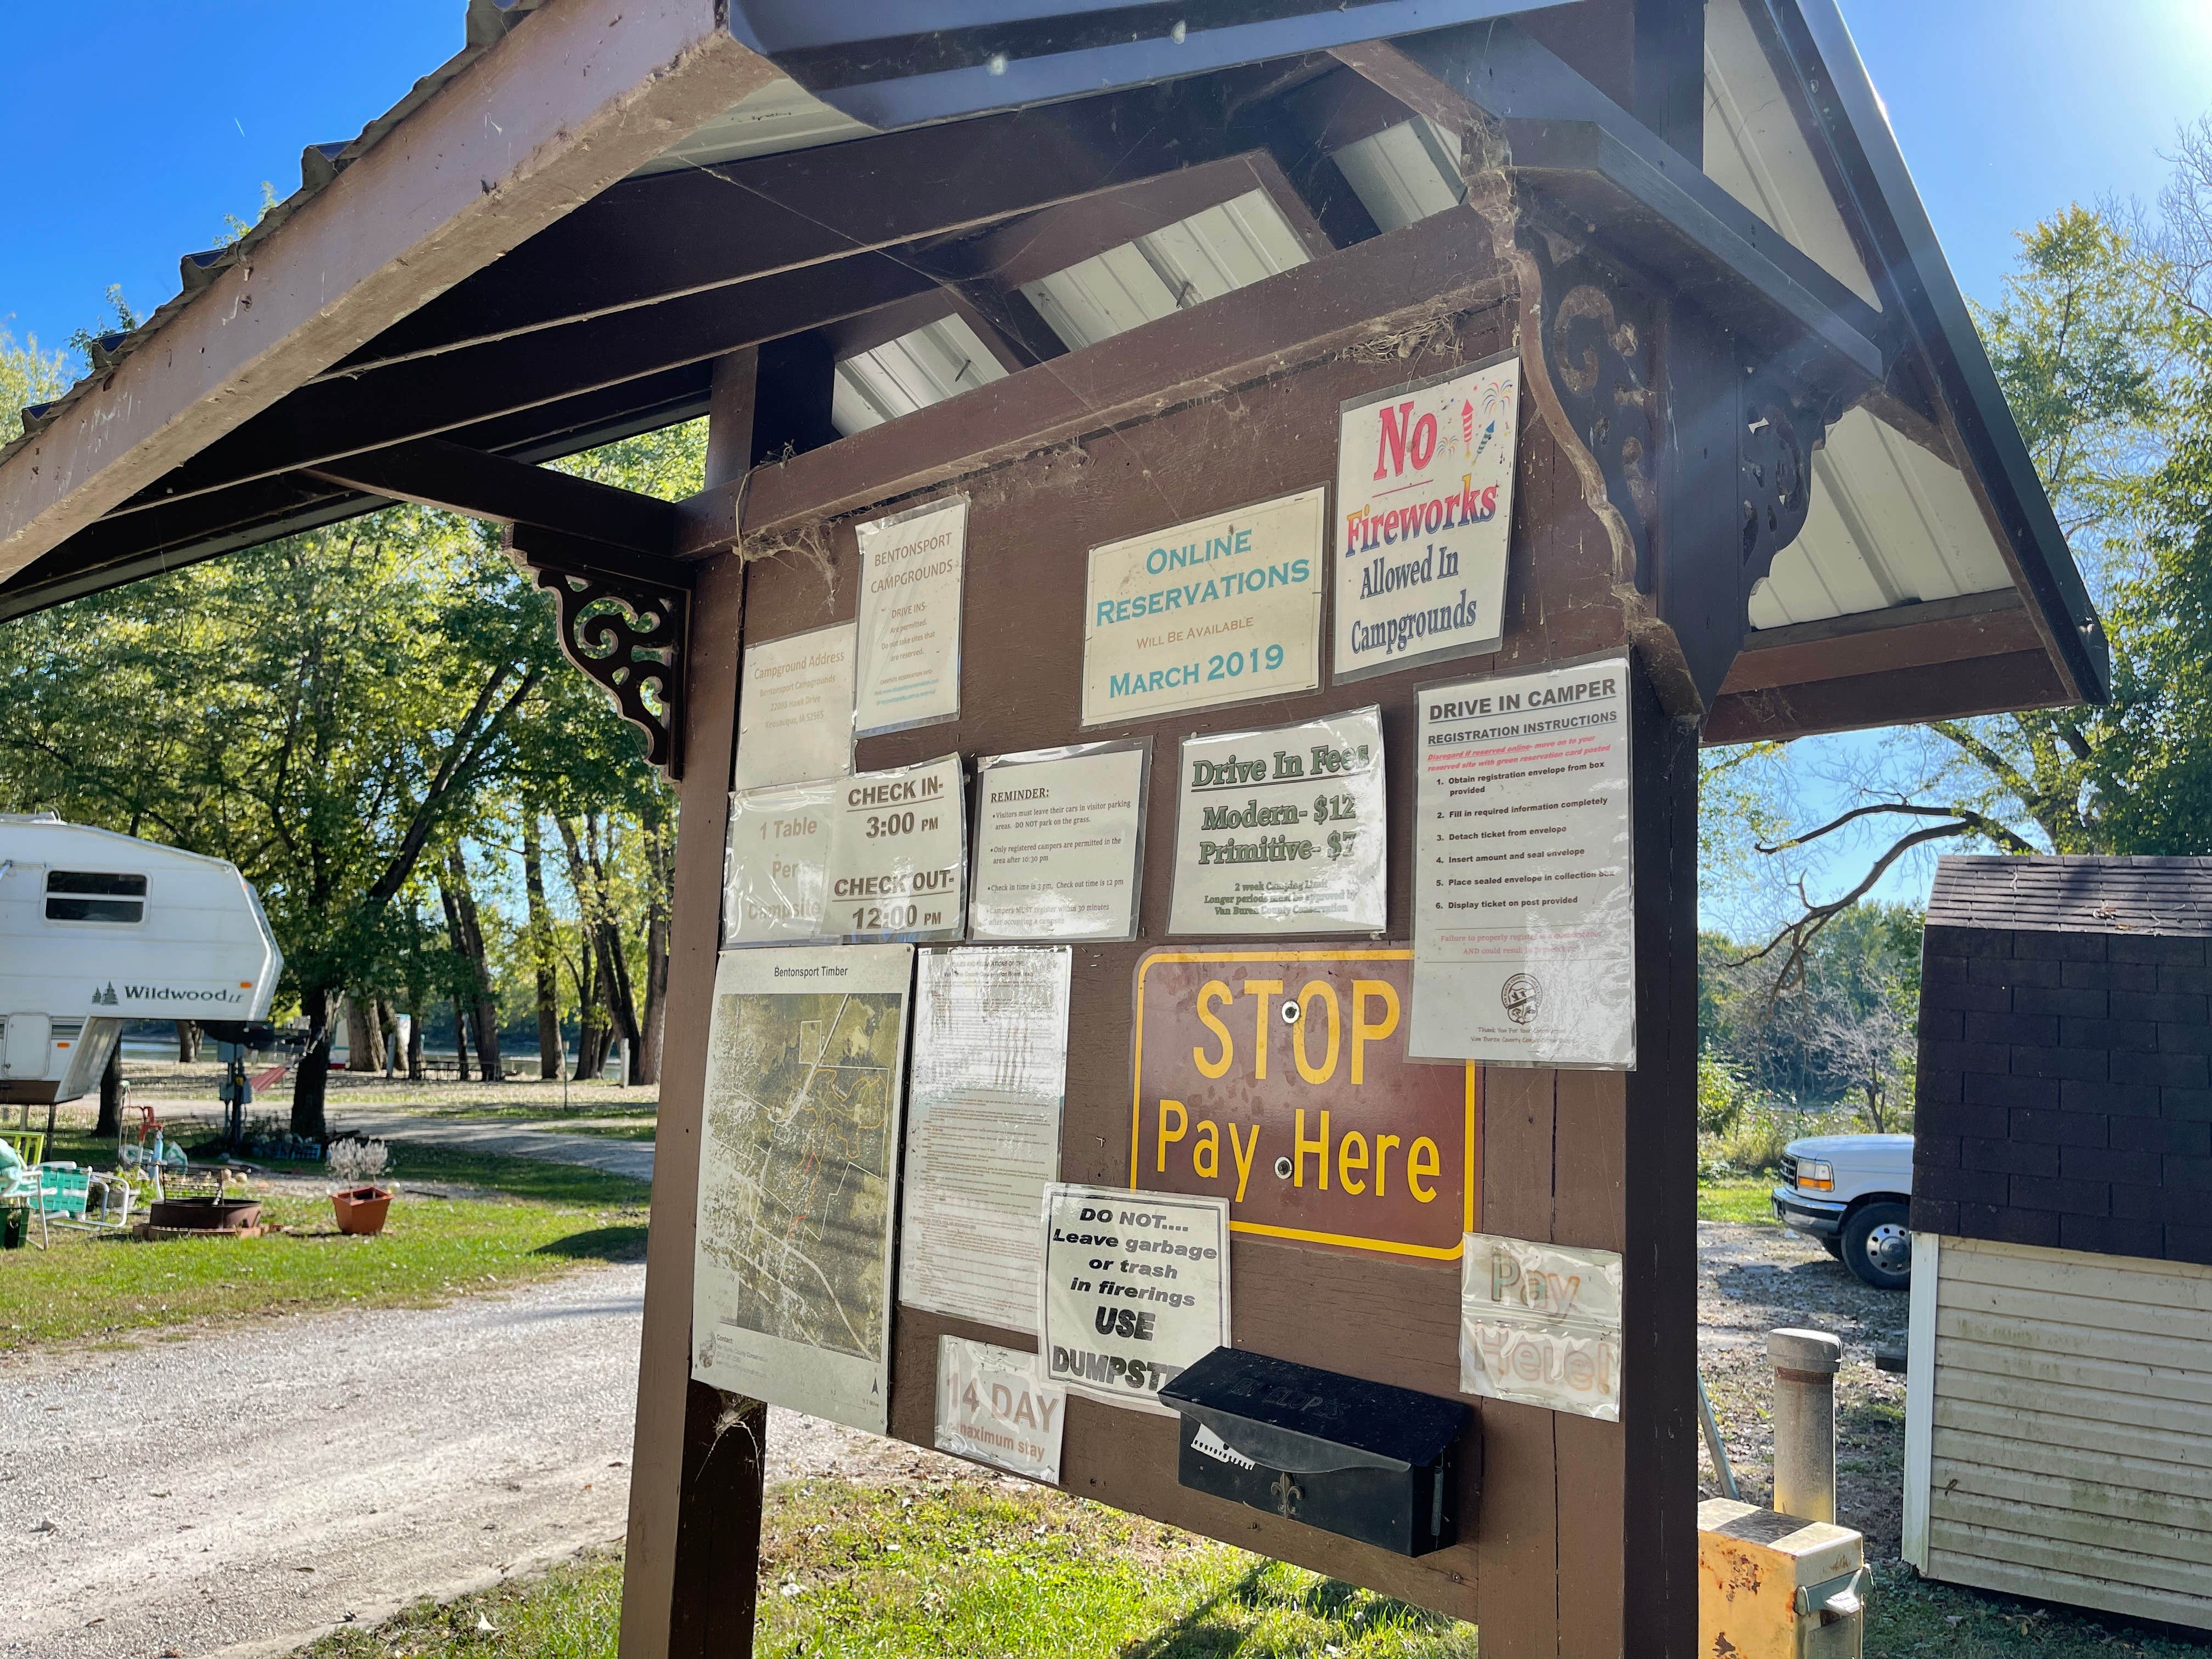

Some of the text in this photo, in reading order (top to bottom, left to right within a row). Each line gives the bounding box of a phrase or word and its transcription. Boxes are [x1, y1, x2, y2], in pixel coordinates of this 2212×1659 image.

[1374, 400, 1437, 481] No
[1345, 473, 1497, 558] Fireworks
[874, 532, 952, 567] BENTONSPORT
[1146, 528, 1252, 575] ONLINE
[871, 559, 952, 593] CAMPGROUNDS
[1361, 544, 1458, 600] Allowed In
[1097, 558, 1310, 627] RESERVATIONS
[891, 606, 912, 618] DRIVE
[1351, 589, 1477, 655] Campgrounds
[1167, 631, 1183, 644] BE
[754, 651, 844, 679] Campground Address
[1110, 644, 1284, 699] MARCH 2019
[760, 675, 836, 697] Bentonsport Campgrounds
[1429, 679, 1616, 720] DRIVE IN CAMPER
[1427, 711, 1617, 744] REGISTRATION INSTRUCTIONS
[1192, 744, 1370, 787] Drive In Fees
[1427, 751, 1463, 761] Disregard
[1472, 747, 1505, 755] reserved
[1448, 775, 1475, 785] Obtain
[1477, 771, 1525, 783] registration
[1528, 766, 1565, 778] envelope
[1567, 763, 1587, 771] from
[1589, 761, 1605, 769] box
[848, 775, 943, 807] CHECK IN-
[990, 788, 1049, 803] REMINDER:
[1450, 786, 1485, 797] provided
[996, 811, 1017, 819] Visitors
[1050, 806, 1064, 814] their
[1087, 803, 1106, 811] visitor
[1108, 800, 1131, 809] parking
[1201, 794, 1356, 831] Modern- $12
[1474, 807, 1508, 816] required
[1511, 802, 1559, 814] information
[1561, 797, 1608, 809] completely
[760, 816, 817, 840] 1 Table
[866, 812, 938, 838] 3:00 PM
[1039, 819, 1052, 828] park
[1074, 816, 1091, 825] grass.
[1481, 830, 1505, 838] ticket
[1529, 826, 1567, 835] envelope
[994, 845, 1007, 854] Only
[1008, 843, 1036, 853] registered
[1037, 842, 1062, 851] campers
[1075, 839, 1103, 849] permitted
[1040, 855, 1048, 864] pm
[1198, 834, 1321, 865] Primitive-
[1448, 855, 1473, 863] Insert
[1476, 854, 1506, 862] amount
[1509, 851, 1525, 860] and
[1547, 848, 1584, 857] envelope
[772, 861, 798, 878] Per
[1474, 877, 1502, 885] sealed
[1504, 874, 1542, 884] envelope
[1554, 871, 1596, 881] collection
[834, 870, 953, 896] CHECK OUT-
[1114, 879, 1124, 887] pm
[1448, 901, 1479, 911] Display
[1481, 900, 1506, 908] ticket
[1521, 898, 1539, 908] post
[1542, 895, 1578, 905] provided
[852, 905, 941, 930] 12:00 PM
[775, 966, 848, 979] Bentonsport Timber
[125, 986, 227, 1001] Wildwood
[1193, 979, 1401, 1085] STOP
[1157, 1099, 1260, 1203] Pay
[1293, 1108, 1441, 1203] Here
[1080, 1208, 1113, 1223] DO
[1053, 1228, 1119, 1248] Leave
[1125, 1239, 1217, 1261] garbage
[1088, 1259, 1178, 1279] or trash
[1070, 1277, 1195, 1307] in firerings
[1491, 1254, 1581, 1324] Pay
[1094, 1306, 1155, 1341] USE
[947, 1373, 1059, 1433] 14 DAY
[958, 1423, 1045, 1463] maximum stay
